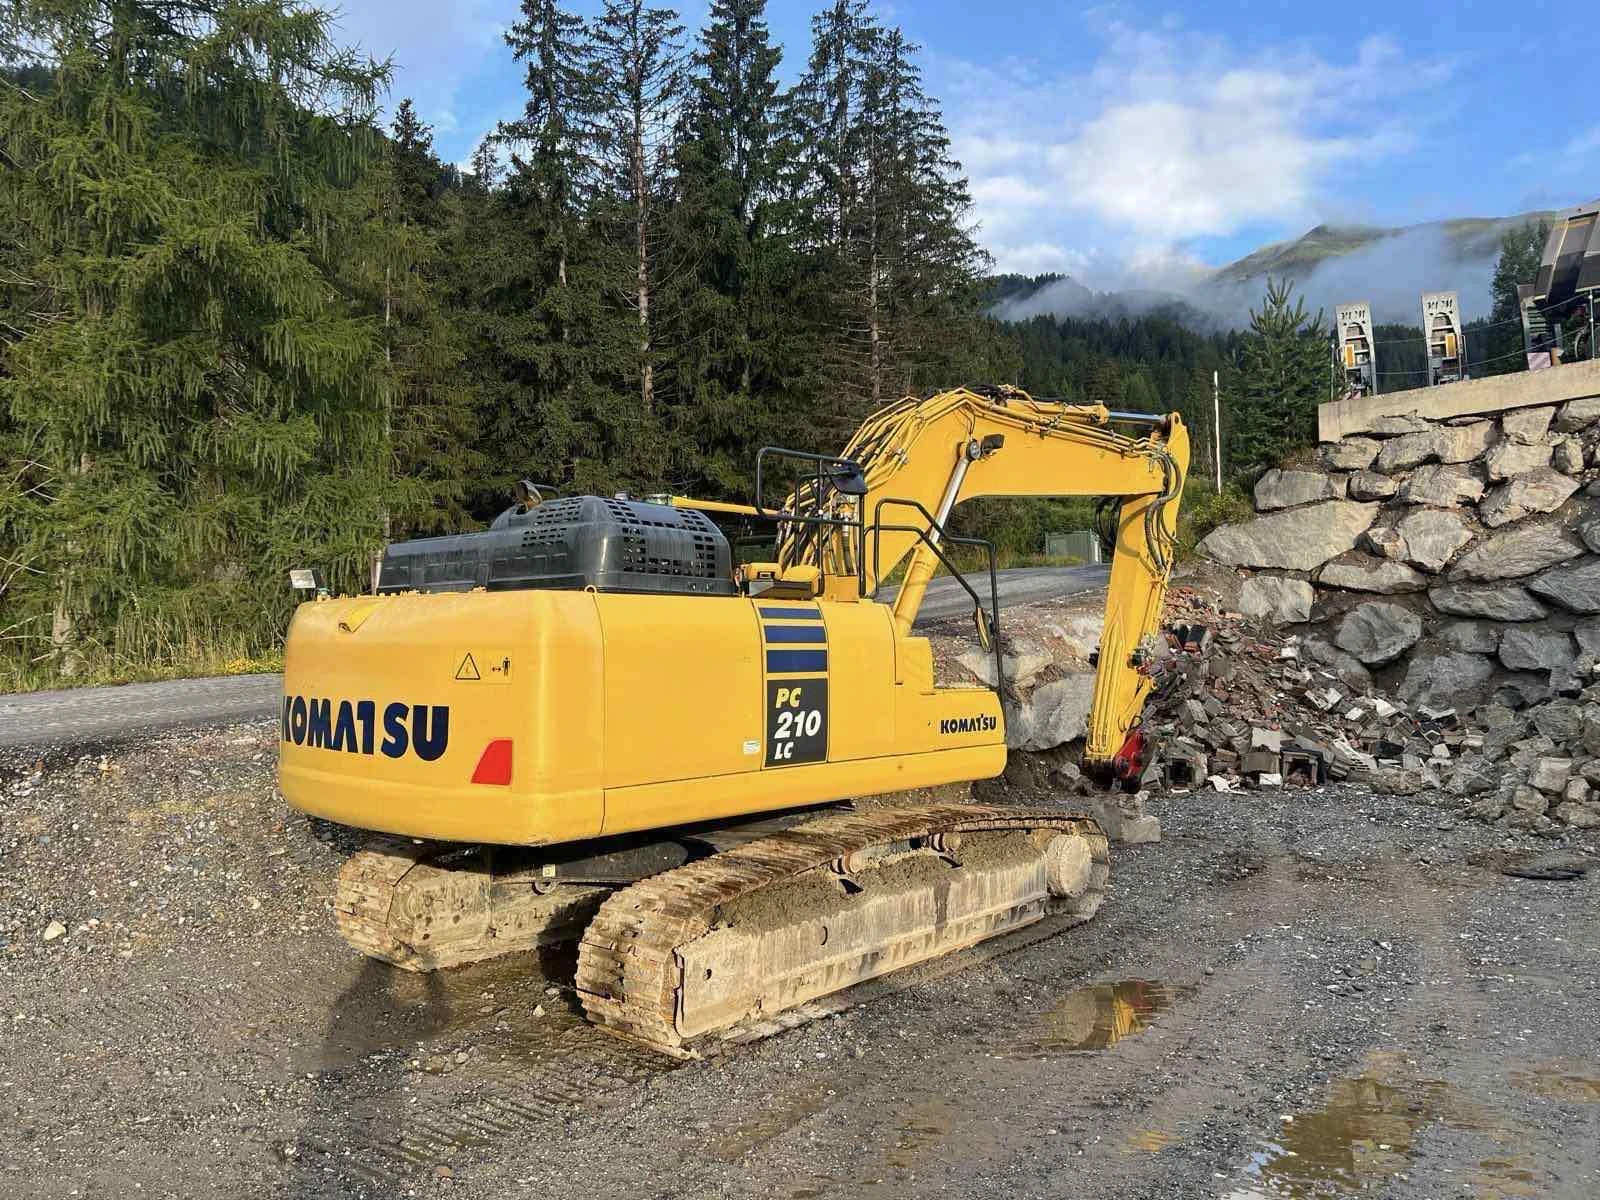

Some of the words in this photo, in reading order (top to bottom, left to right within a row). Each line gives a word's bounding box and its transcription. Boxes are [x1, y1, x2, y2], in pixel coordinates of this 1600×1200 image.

[775, 687, 802, 708] PC
[283, 695, 449, 761] KOMATSU
[774, 709, 822, 739] 210
[940, 713, 997, 734] KOMATSU
[774, 741, 794, 760] LC
